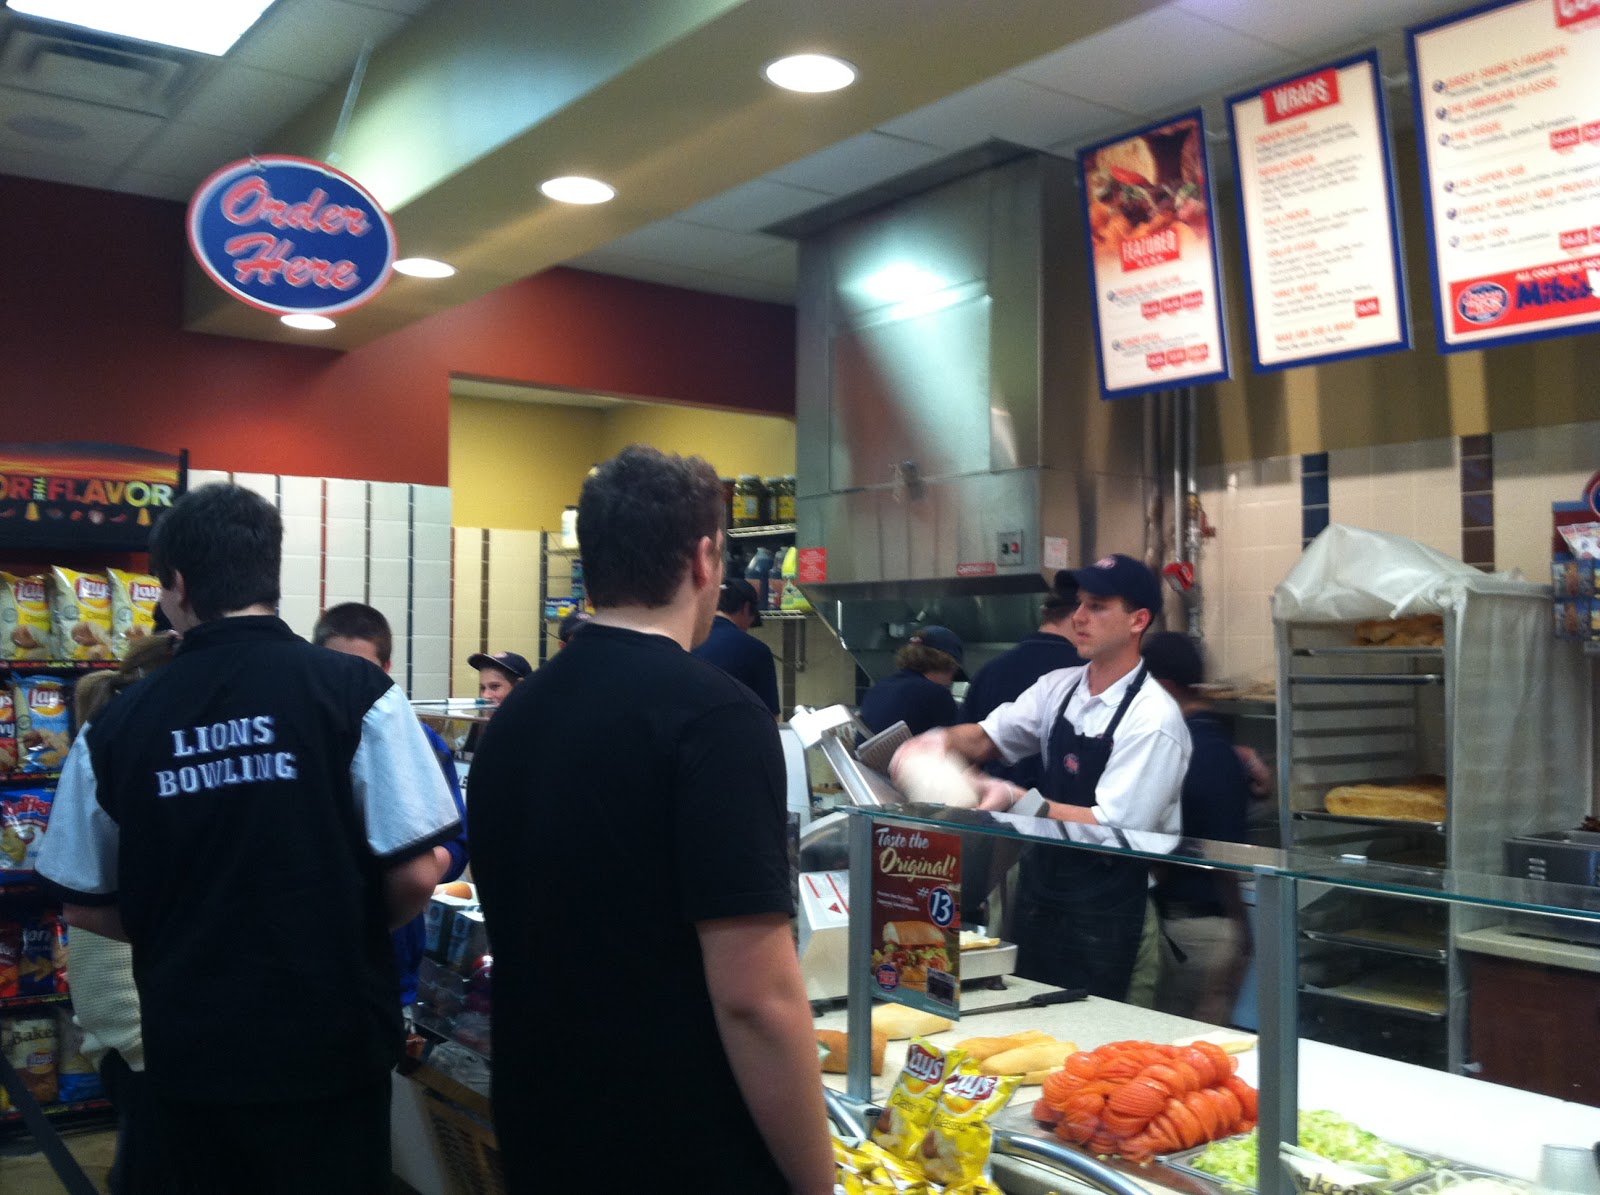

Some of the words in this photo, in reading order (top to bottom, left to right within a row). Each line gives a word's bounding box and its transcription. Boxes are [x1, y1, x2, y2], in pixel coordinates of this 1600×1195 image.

[1272, 77, 1331, 116] WRAPS
[220, 176, 372, 237] Order
[224, 231, 361, 291] Here
[51, 478, 174, 508] FLAVOR
[171, 715, 276, 757] LIONS
[155, 751, 298, 797] BOWLING
[875, 827, 907, 849] Taste
[908, 832, 929, 849] the
[879, 847, 957, 882] Original!
